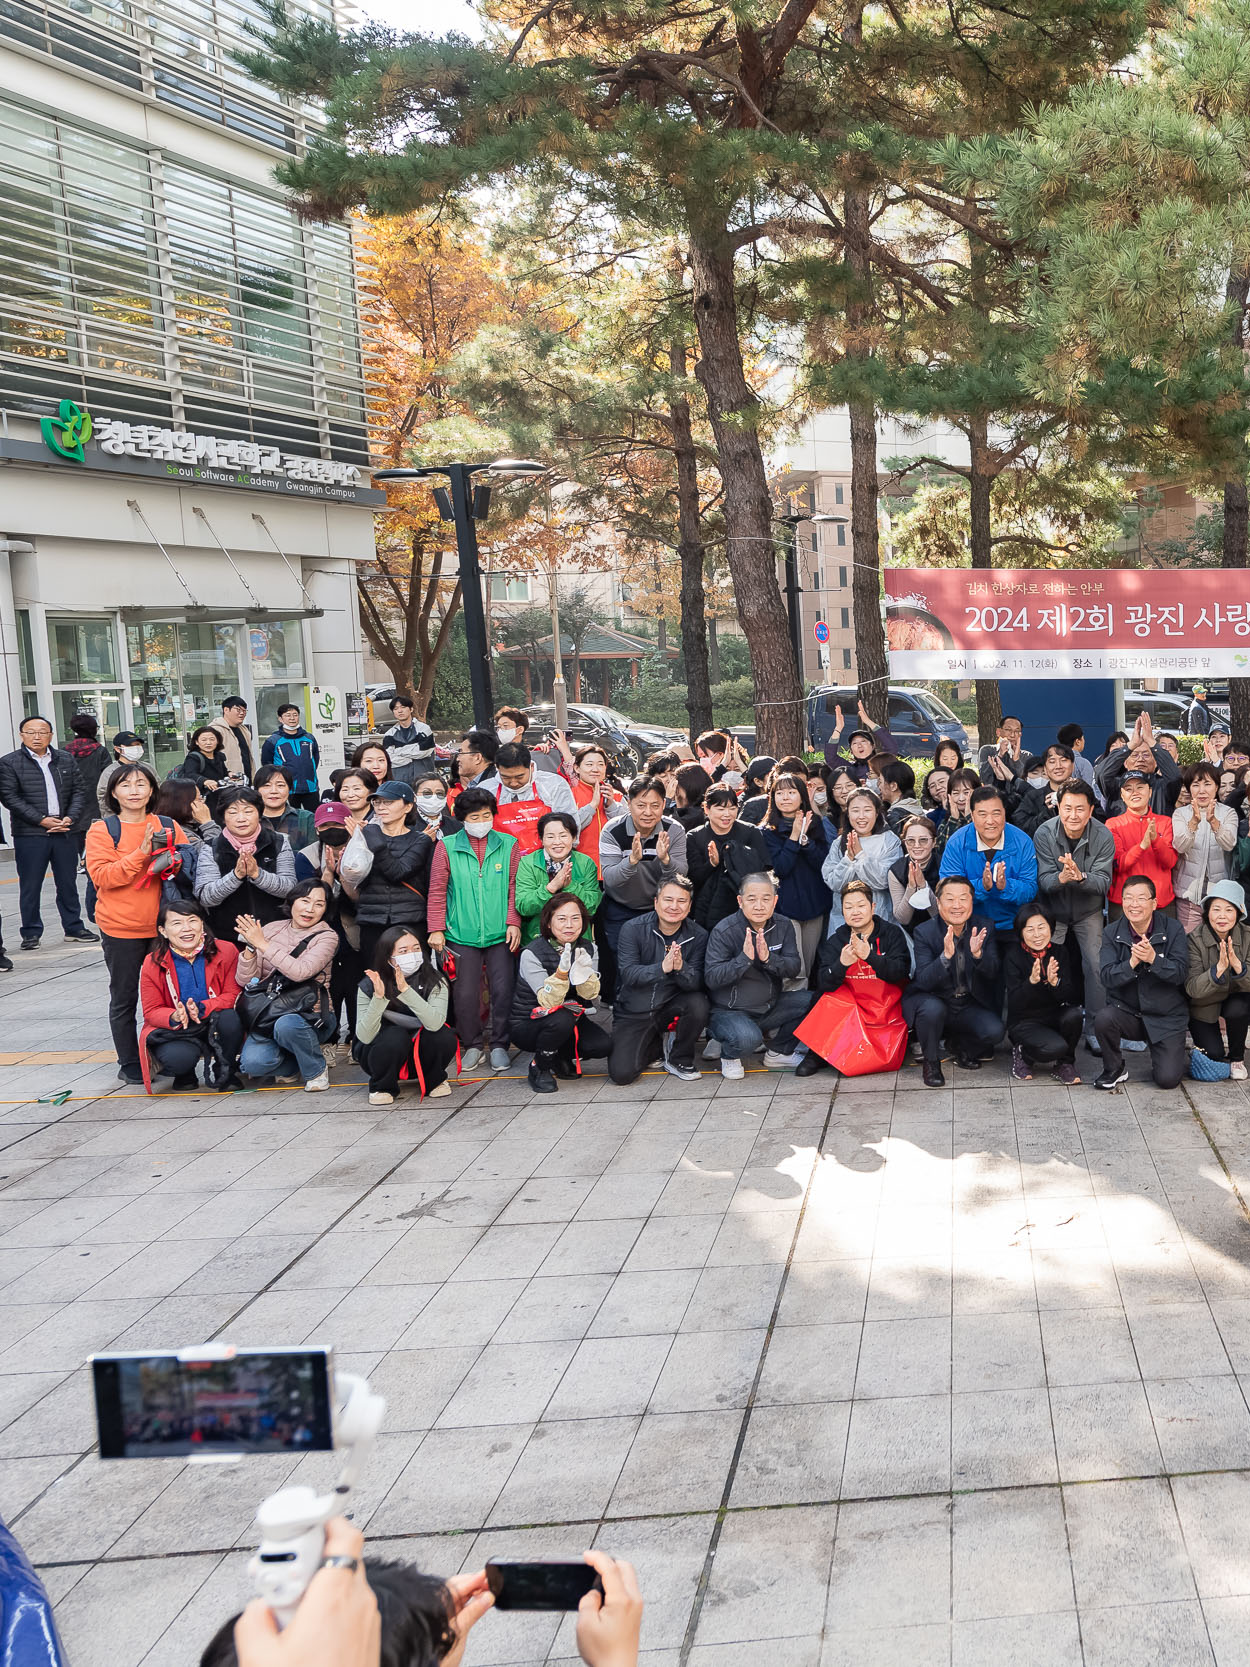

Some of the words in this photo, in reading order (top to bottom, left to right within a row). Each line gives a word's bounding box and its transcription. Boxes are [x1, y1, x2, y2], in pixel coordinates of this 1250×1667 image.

[92, 417, 283, 475] 청년취업사관학교
[166, 464, 194, 477] Seoul
[195, 469, 235, 482] Software
[238, 474, 280, 490] ACademy
[286, 480, 323, 496] Gwangjin
[325, 486, 356, 498] Campus
[966, 582, 988, 595] 김치
[991, 582, 1040, 595] 한상자로
[1042, 582, 1078, 595] 전하는
[1080, 582, 1105, 596] 안부
[965, 606, 1031, 632] 2024
[1037, 602, 1114, 637] 제2회
[1125, 602, 1185, 637] 광진
[947, 659, 967, 669] 일시
[1073, 658, 1093, 669] 장소
[1109, 657, 1198, 669] 광진구시설관리공단
[1202, 657, 1211, 668] 앞
